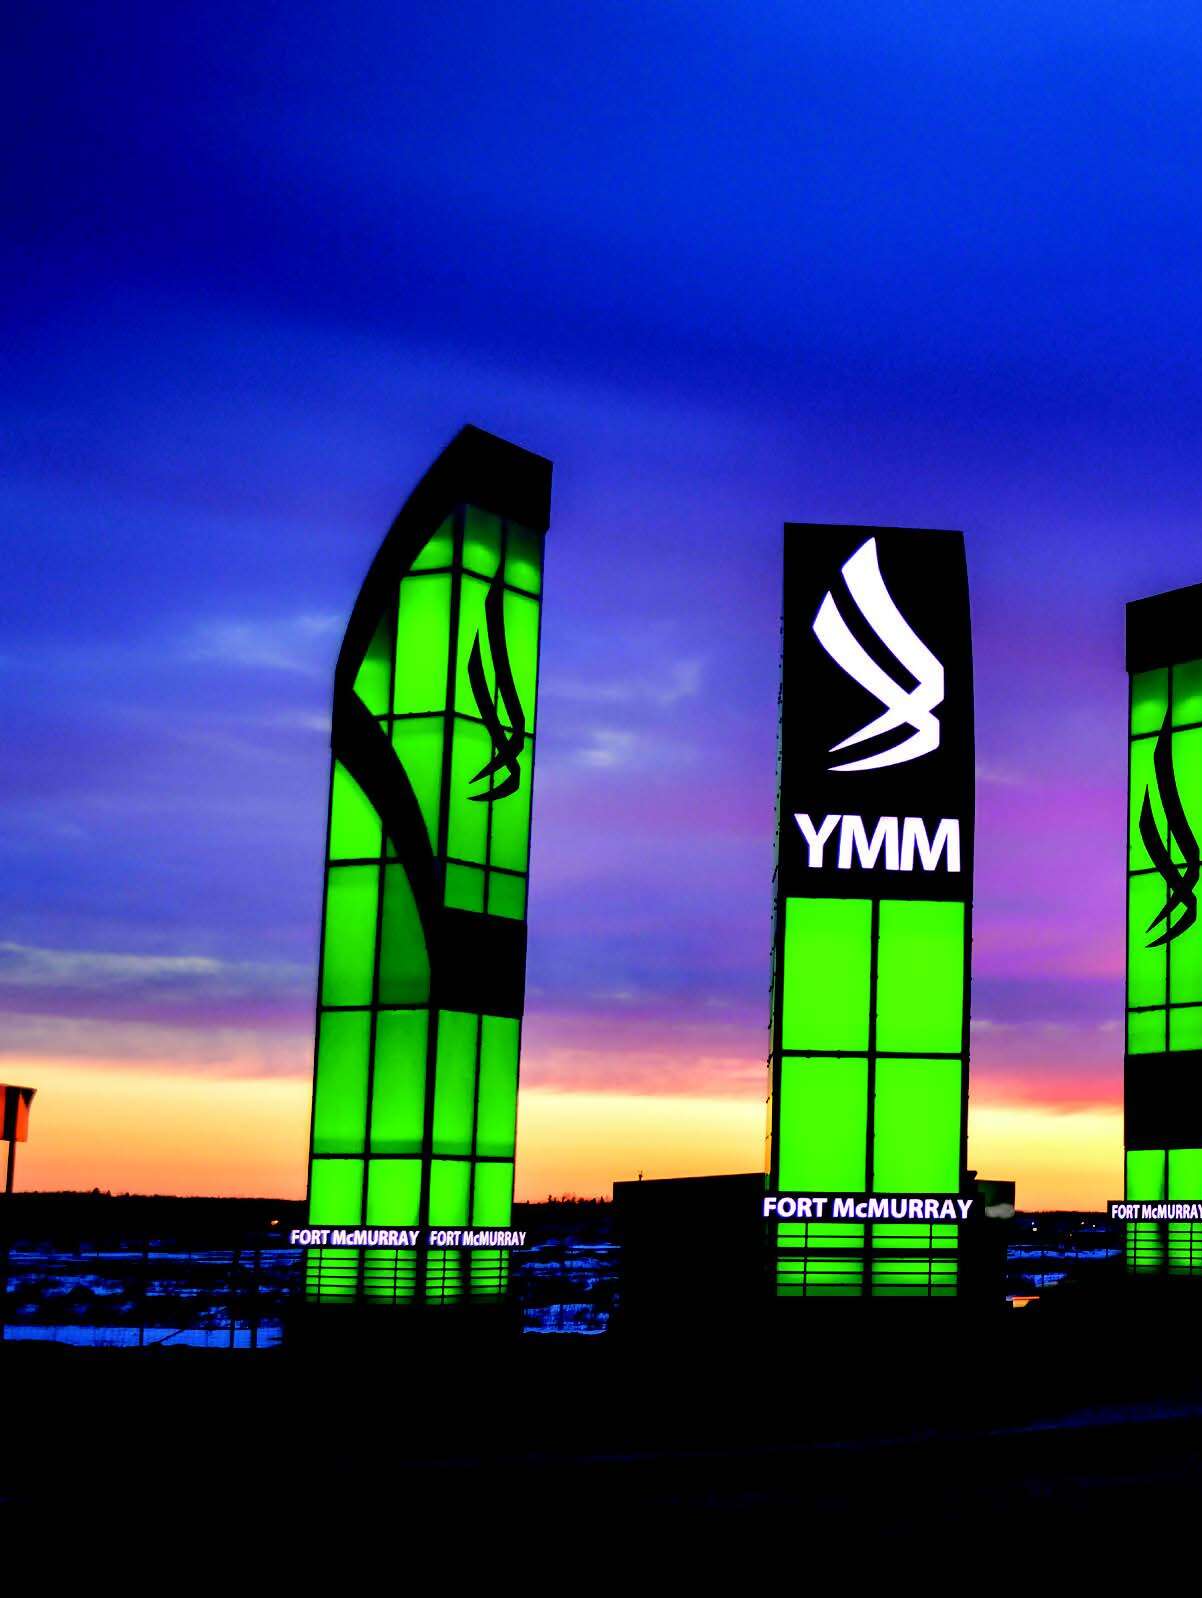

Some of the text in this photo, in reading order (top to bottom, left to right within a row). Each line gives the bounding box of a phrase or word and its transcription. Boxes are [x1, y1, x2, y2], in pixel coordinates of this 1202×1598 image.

[793, 813, 961, 873] YMM
[763, 1196, 974, 1220] FORT McMURRAY
[1111, 1203, 1141, 1220] FORT
[290, 1229, 421, 1247] FORT McMURRAY
[429, 1230, 527, 1247] FORT McMURRAY
